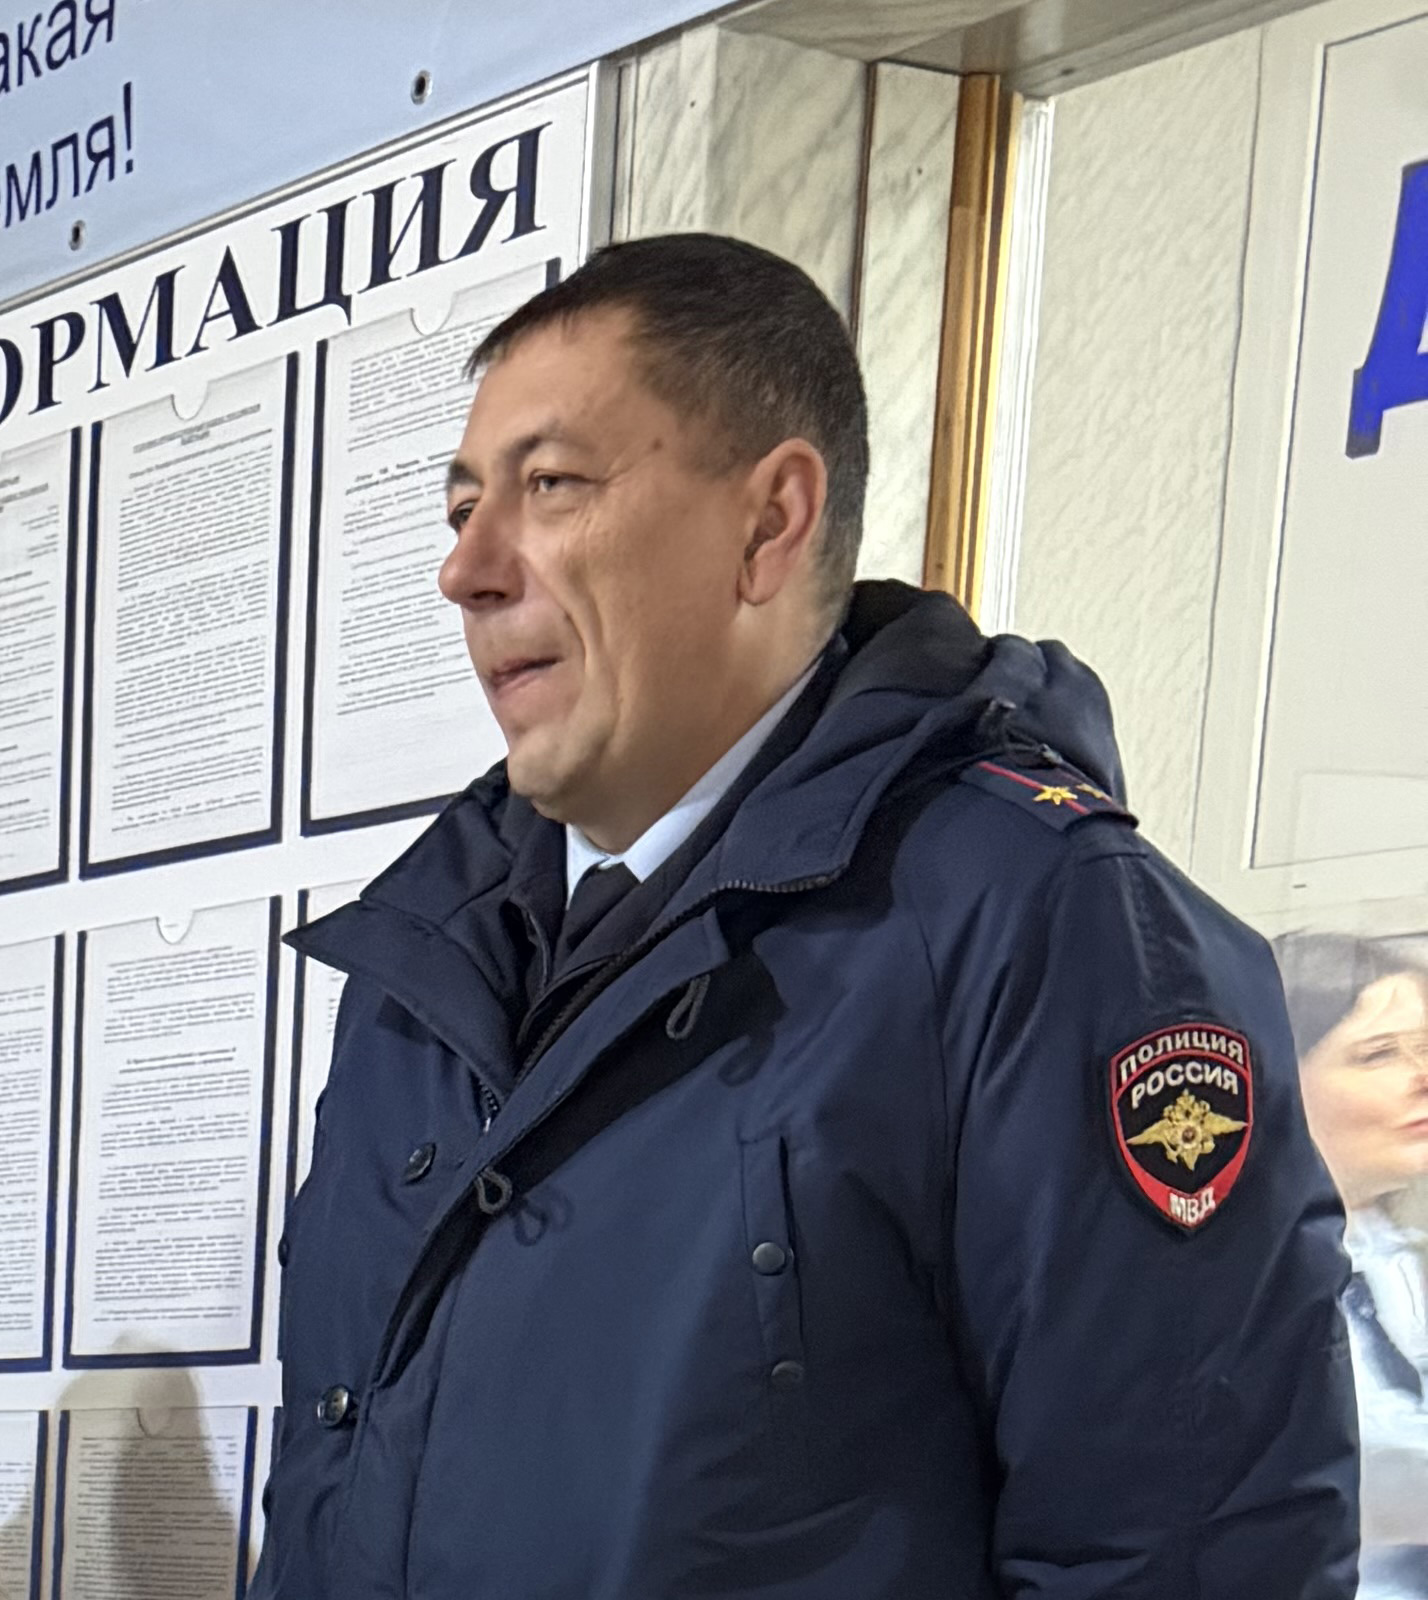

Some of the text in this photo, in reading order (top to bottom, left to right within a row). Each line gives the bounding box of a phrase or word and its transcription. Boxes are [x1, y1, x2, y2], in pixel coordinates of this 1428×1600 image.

[1120, 1030, 1244, 1084] ПОЛИЦИЯ
[1131, 1061, 1239, 1110] РОССИЯ
[1169, 1187, 1217, 1224] МВД
